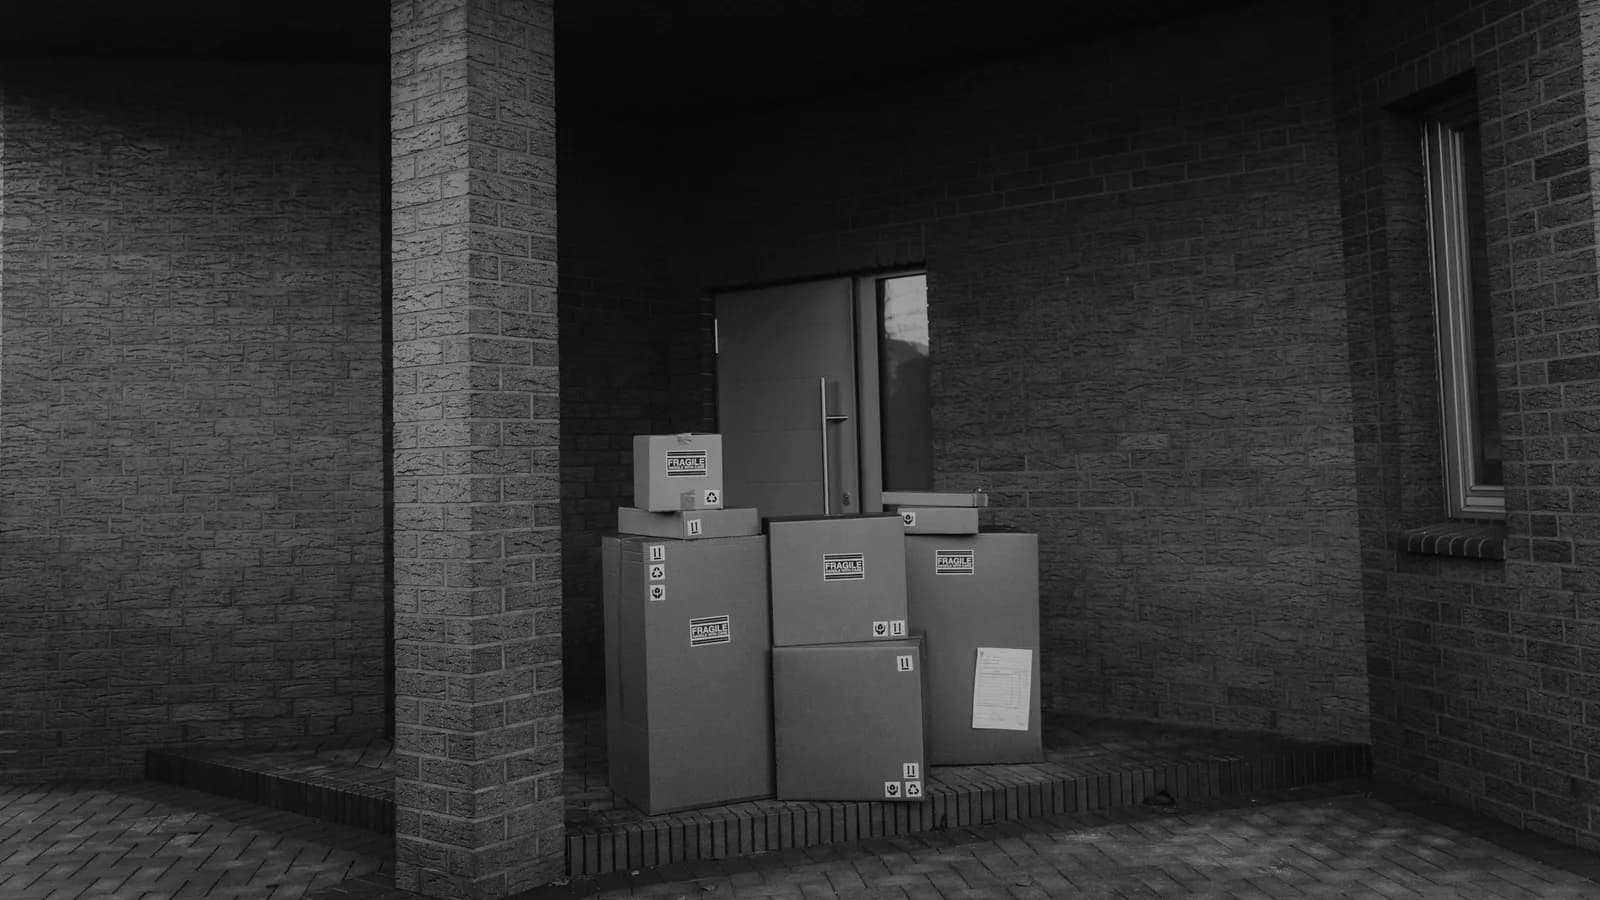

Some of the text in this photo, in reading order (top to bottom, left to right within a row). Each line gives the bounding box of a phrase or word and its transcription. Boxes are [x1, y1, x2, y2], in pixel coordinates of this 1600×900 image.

[668, 458, 705, 466] FRAGILE
[825, 561, 862, 570] FRAGILE
[692, 624, 727, 635] FRAGILE
